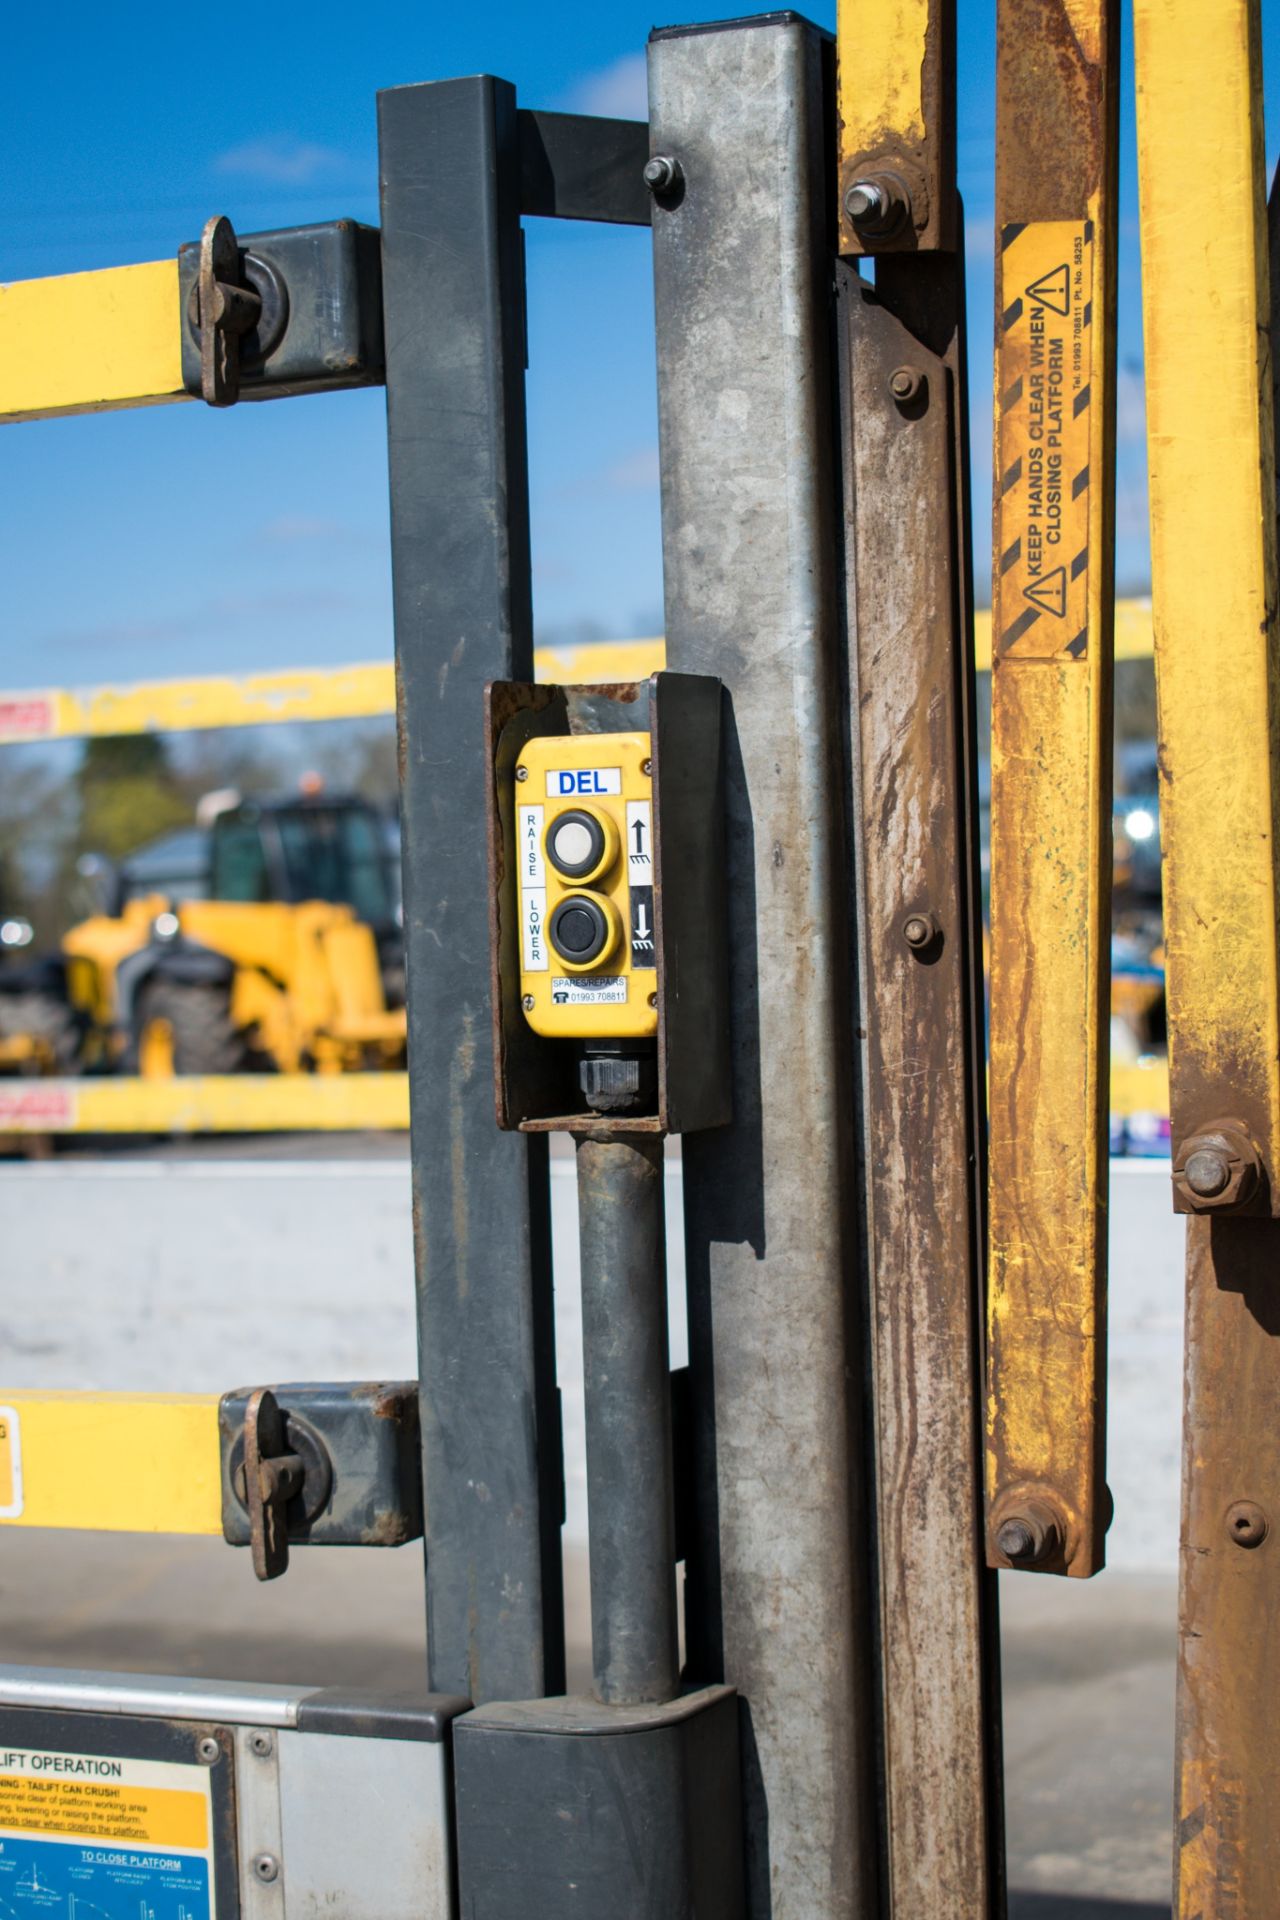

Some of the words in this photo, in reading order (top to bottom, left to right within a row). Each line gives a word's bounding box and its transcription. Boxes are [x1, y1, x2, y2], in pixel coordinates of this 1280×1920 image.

[1074, 237, 1083, 264] 58253
[1074, 269, 1082, 285] No.
[1074, 287, 1082, 301] Pt.
[1074, 307, 1082, 340] 708811
[1030, 307, 1045, 368] WHEN
[1073, 343, 1081, 371] 01993
[1047, 338, 1063, 447] PLATFORM
[1072, 372, 1081, 390] Tel.
[1029, 374, 1044, 441] CLEAR
[1028, 447, 1043, 517] HANDS
[1046, 454, 1061, 545] CLOSING
[1028, 524, 1042, 576] KEEP
[559, 771, 608, 794] DEL
[527, 815, 536, 876] RAISE
[529, 899, 541, 960] LOWER
[553, 978, 624, 988] SPARES/REPAIRS
[571, 992, 595, 1002] 01993
[598, 991, 625, 1001] 708811
[31, 1755, 123, 1777] OPERATION
[28, 1781, 59, 1792] TAILIFT
[62, 1784, 82, 1794] CAN
[84, 1786, 120, 1798] CRUSH!
[59, 1797, 92, 1807] platform
[95, 1801, 126, 1812] working
[91, 1812, 104, 1821] the
[81, 1850, 94, 1861] TO
[96, 1852, 128, 1865] CLOSE
[130, 1856, 181, 1870] PLATFORM
